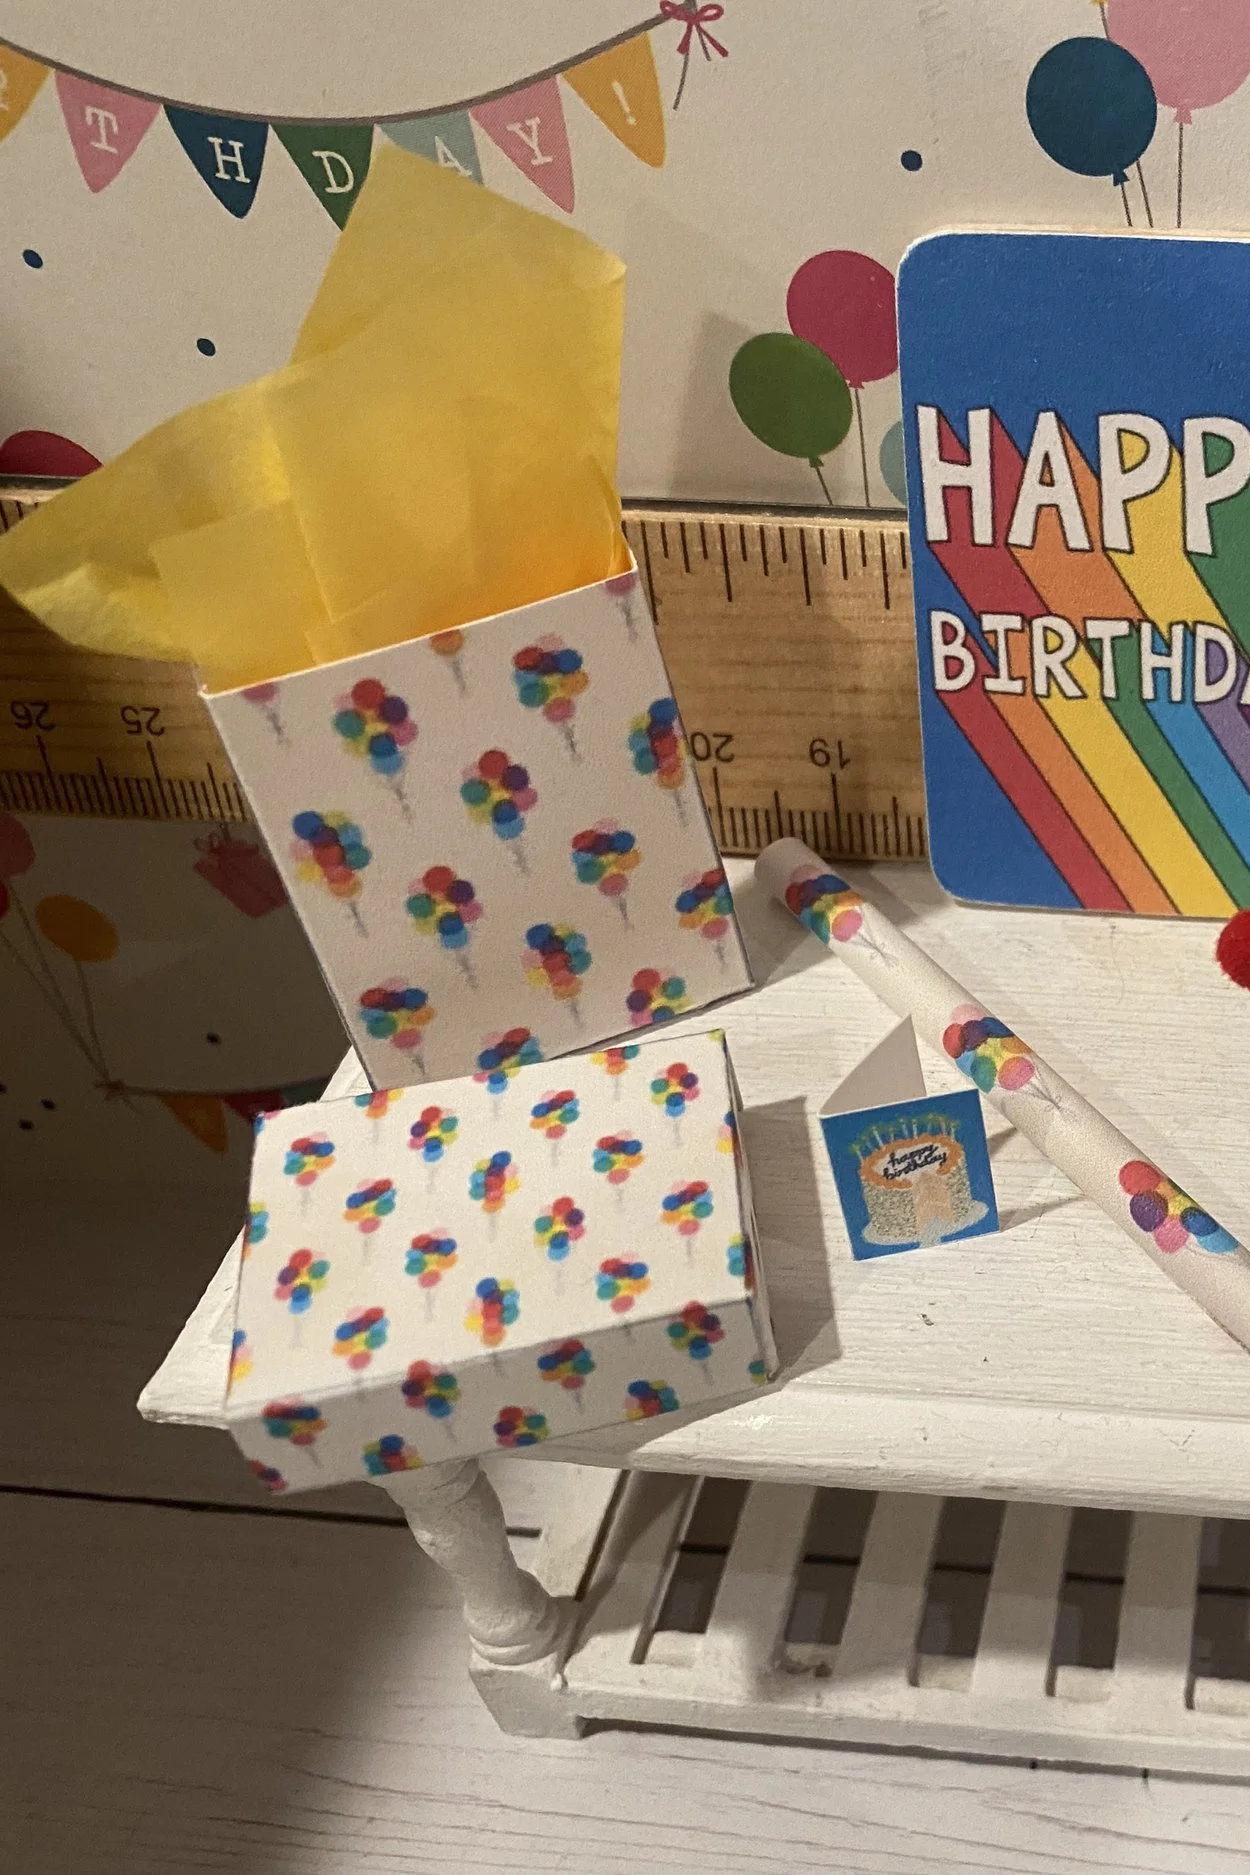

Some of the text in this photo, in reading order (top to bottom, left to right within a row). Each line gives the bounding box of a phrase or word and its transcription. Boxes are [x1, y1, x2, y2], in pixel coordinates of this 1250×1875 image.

[10, 701, 56, 730] 26
[120, 705, 165, 736] 25
[689, 732, 735, 763] 20
[809, 738, 851, 770] 19
[888, 1144, 939, 1167] happy
